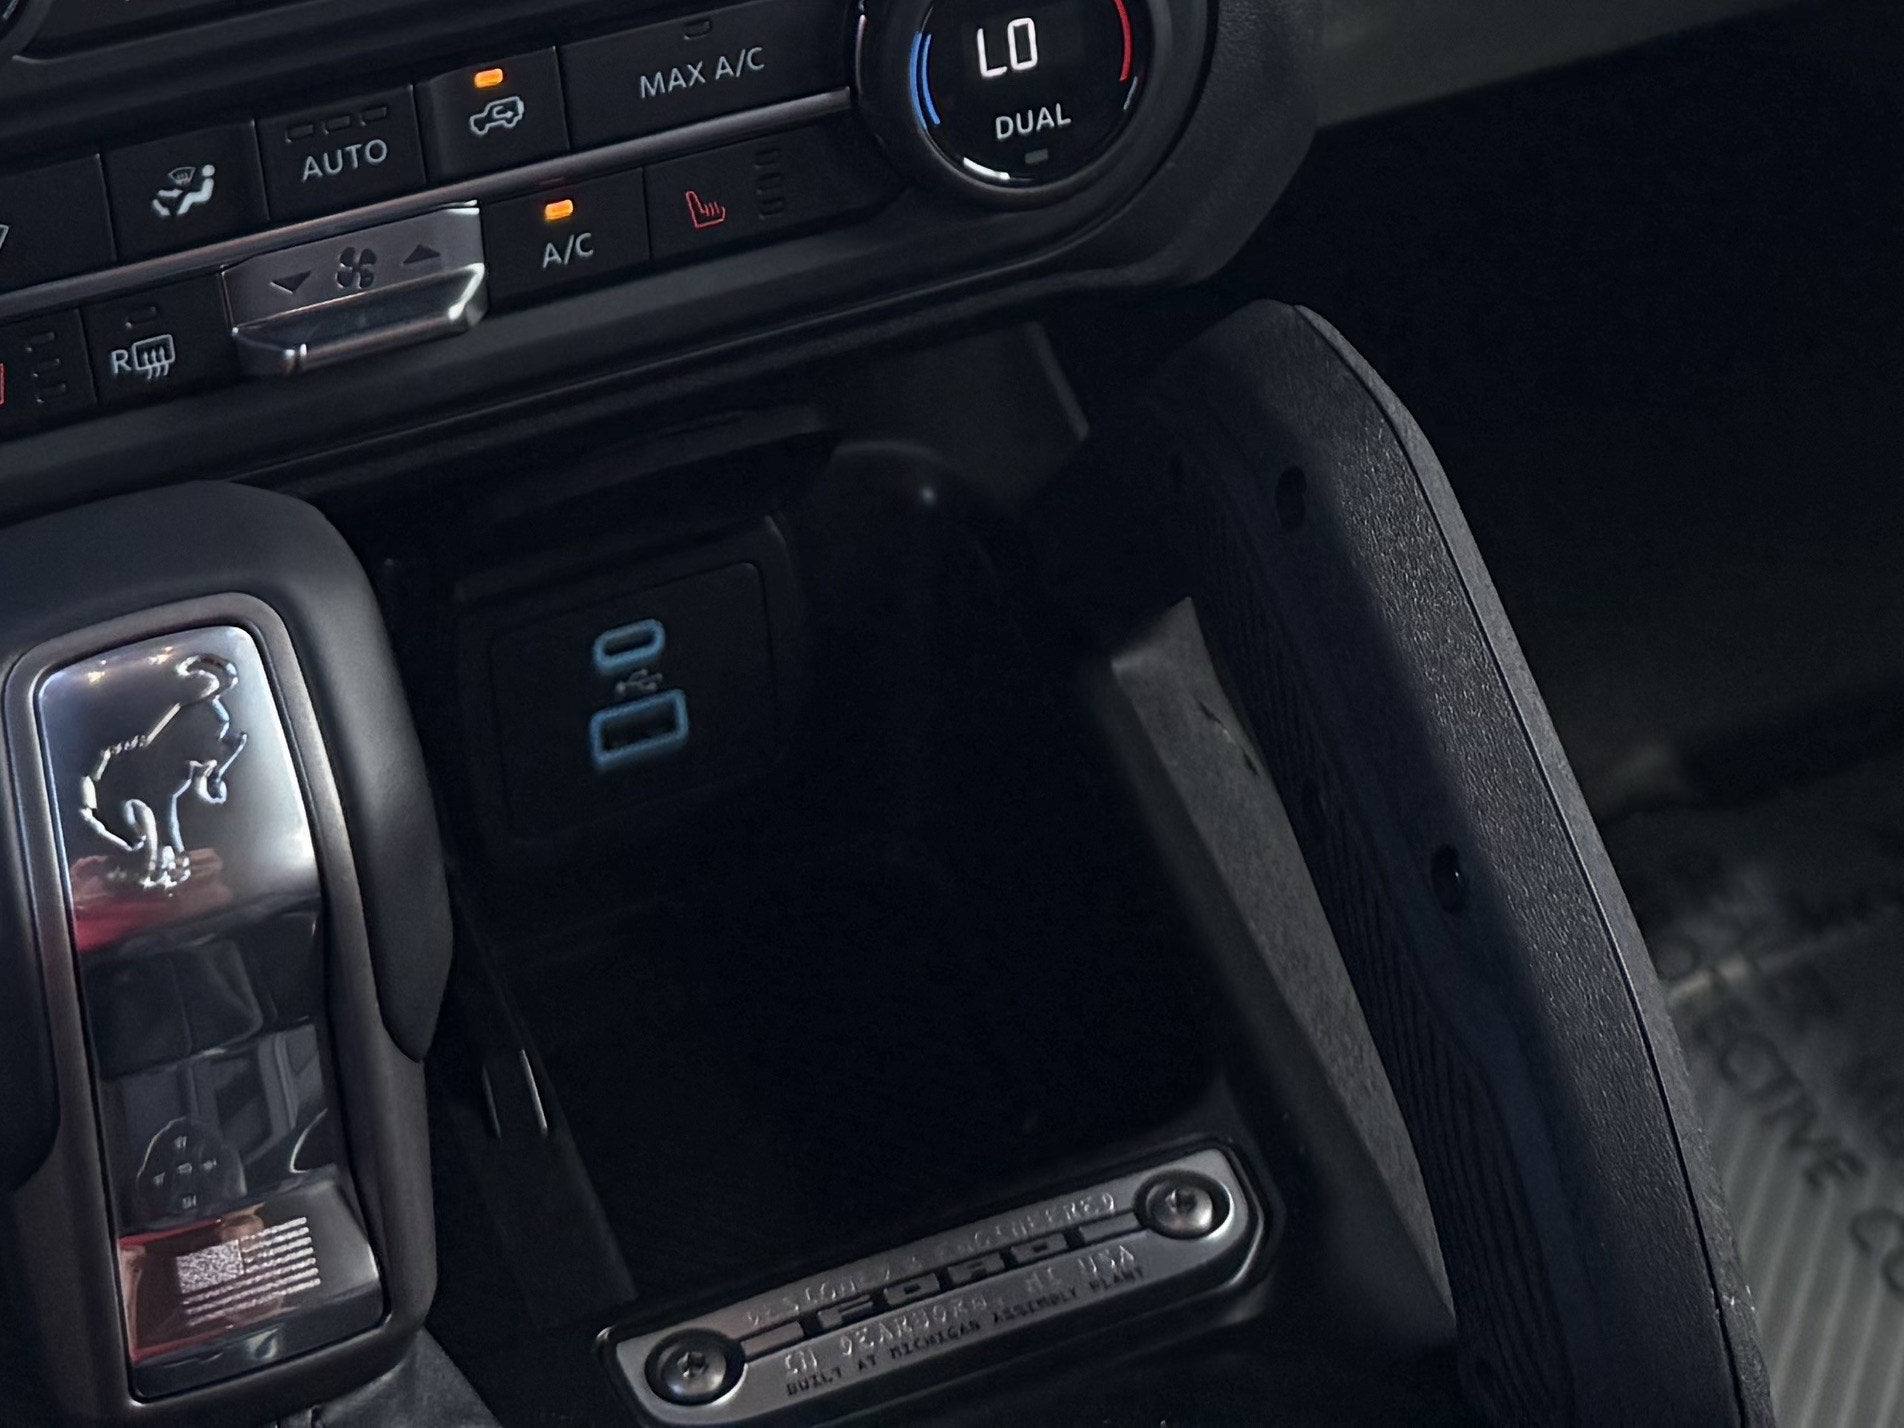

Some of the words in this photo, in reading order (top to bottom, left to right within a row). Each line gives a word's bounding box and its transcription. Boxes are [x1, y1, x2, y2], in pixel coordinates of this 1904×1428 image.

[975, 17, 1039, 80] LO
[639, 62, 706, 101] MAX
[713, 45, 766, 85] A/C
[994, 103, 1072, 141] DUAL
[301, 138, 389, 182] AUTO
[542, 230, 595, 270] A/C
[112, 350, 131, 375] R
[1076, 1244, 1136, 1278] USA
